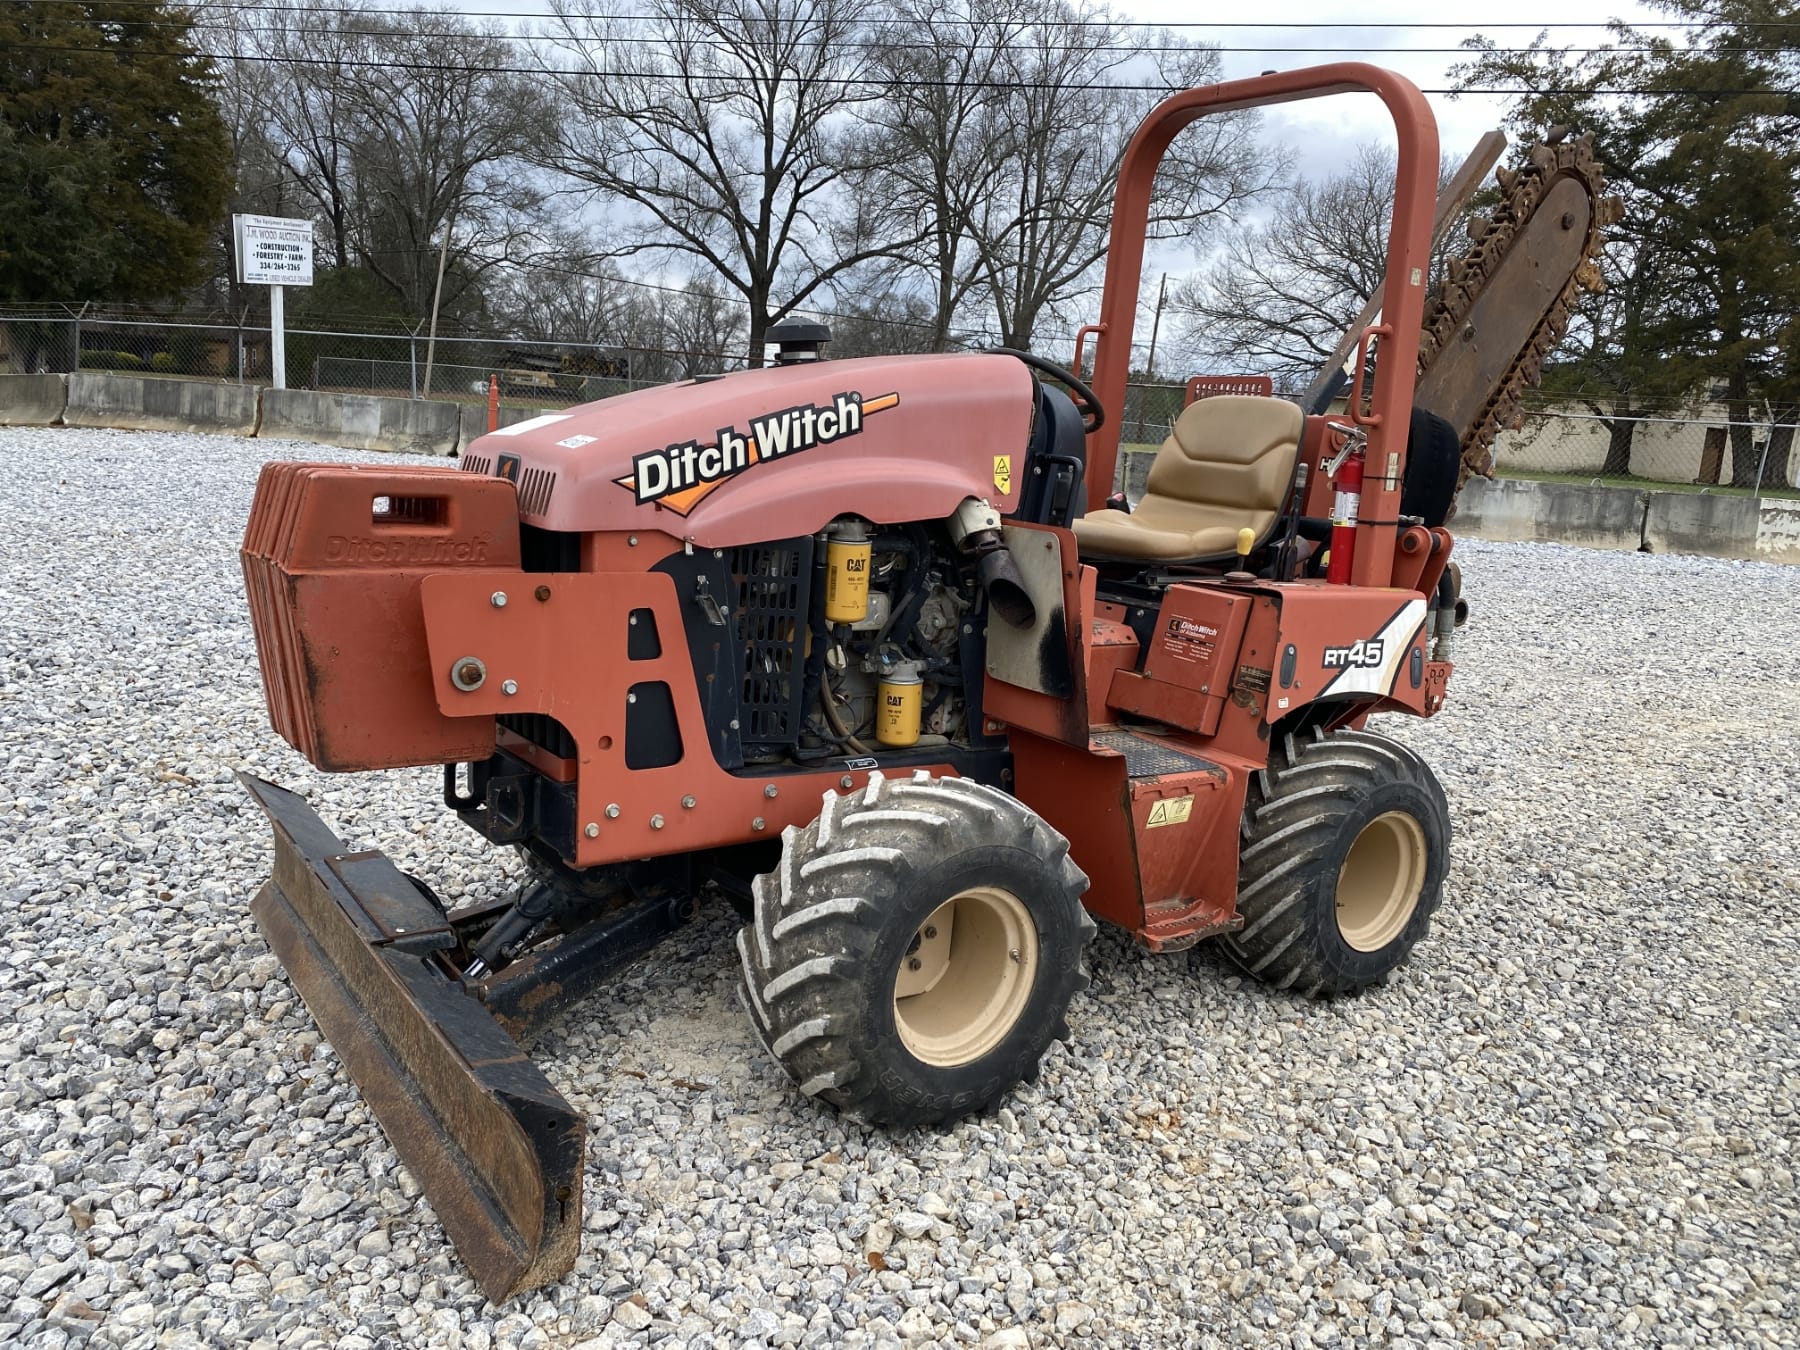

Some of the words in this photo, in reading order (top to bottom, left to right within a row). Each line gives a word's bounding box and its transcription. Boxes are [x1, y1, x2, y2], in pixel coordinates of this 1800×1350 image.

[259, 229, 277, 240] WOOD
[279, 231, 300, 242] AUCTION
[260, 242, 299, 252] CONSTRUCTION
[256, 251, 283, 260] FORESTRY
[288, 254, 303, 262] FARM
[637, 431, 746, 500] Ditch
[324, 535, 405, 562] Ditch
[847, 558, 867, 572] CAT
[1181, 621, 1199, 632] Ditch
[1199, 625, 1217, 636] Witch
[1324, 642, 1382, 666] RT45
[887, 695, 904, 707] CAT
